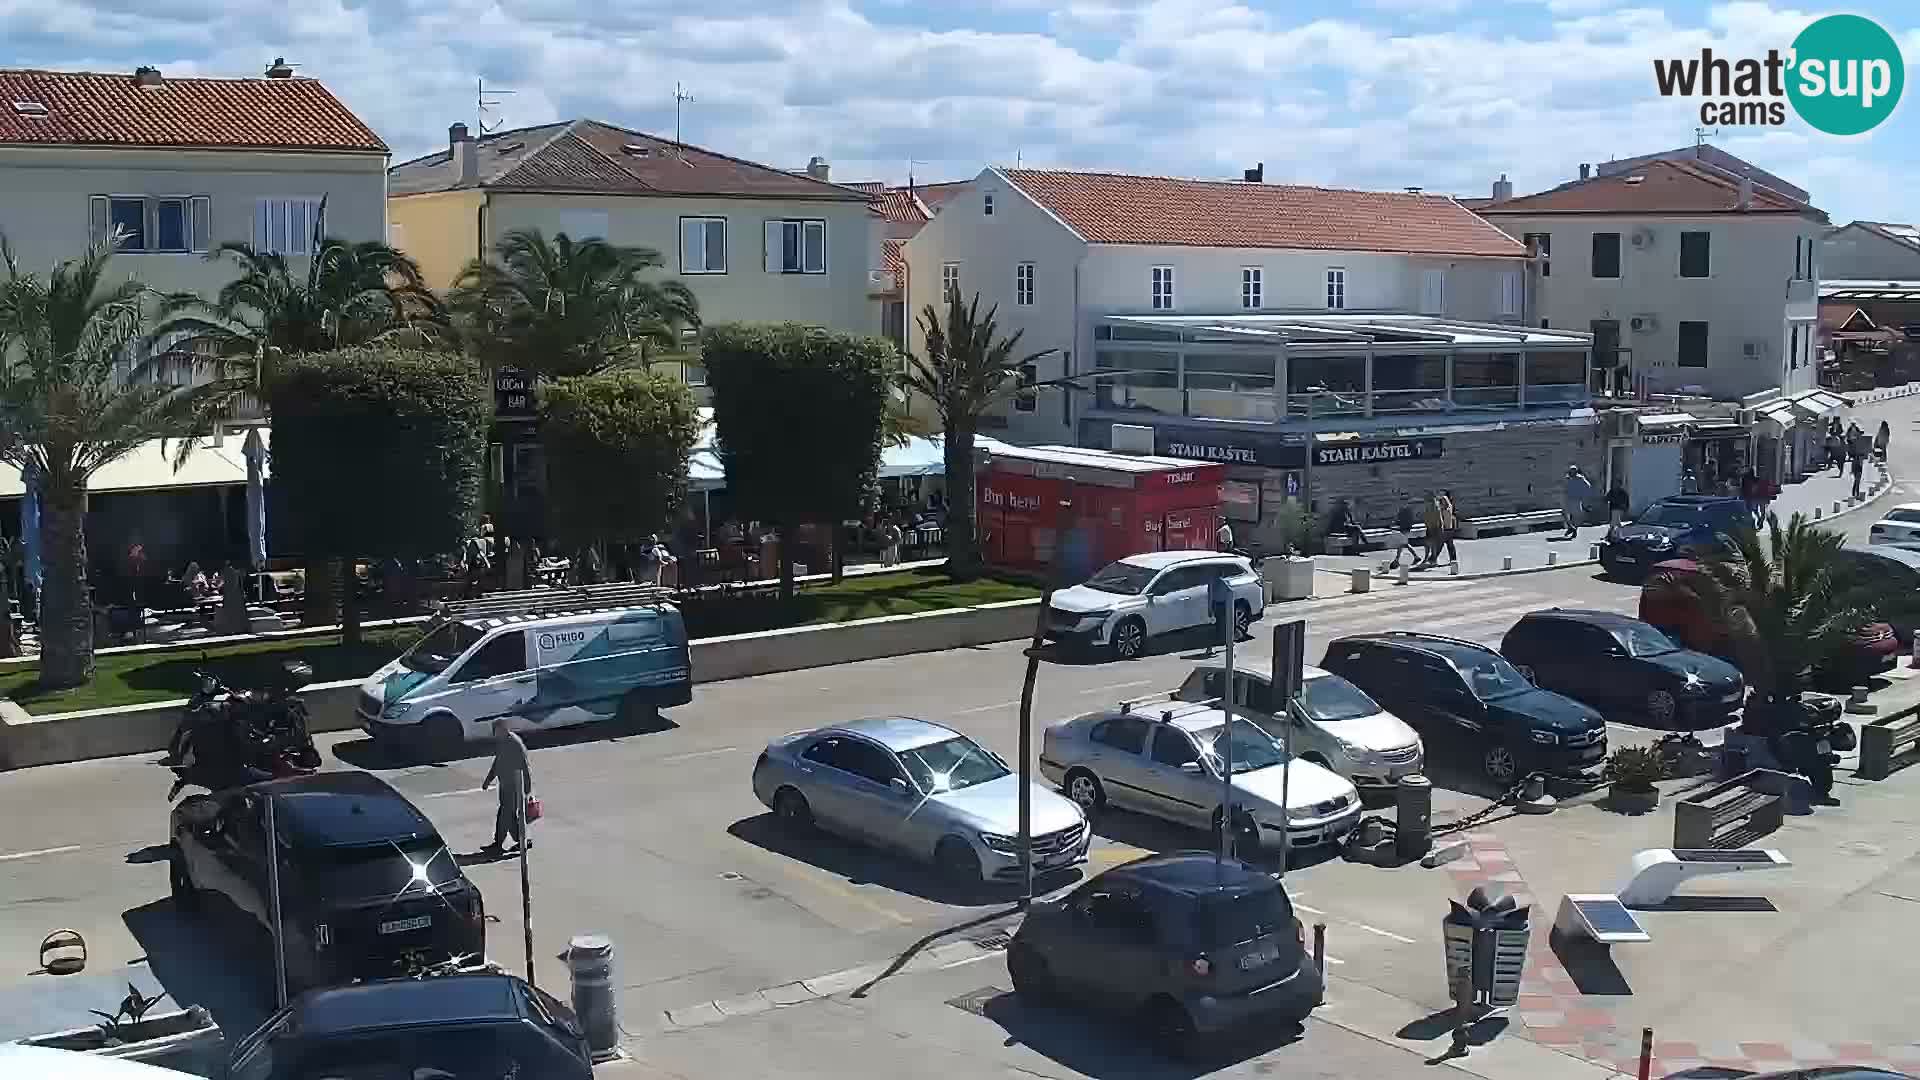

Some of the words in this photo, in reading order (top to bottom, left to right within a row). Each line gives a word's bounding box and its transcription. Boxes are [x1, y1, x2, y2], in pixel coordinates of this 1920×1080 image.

[1169, 443, 1205, 457] STARI
[1208, 444, 1257, 462] KAŠTEL
[1319, 447, 1360, 463] STARI
[1362, 442, 1411, 460] KAŠTEL
[1144, 519, 1163, 533] Buy
